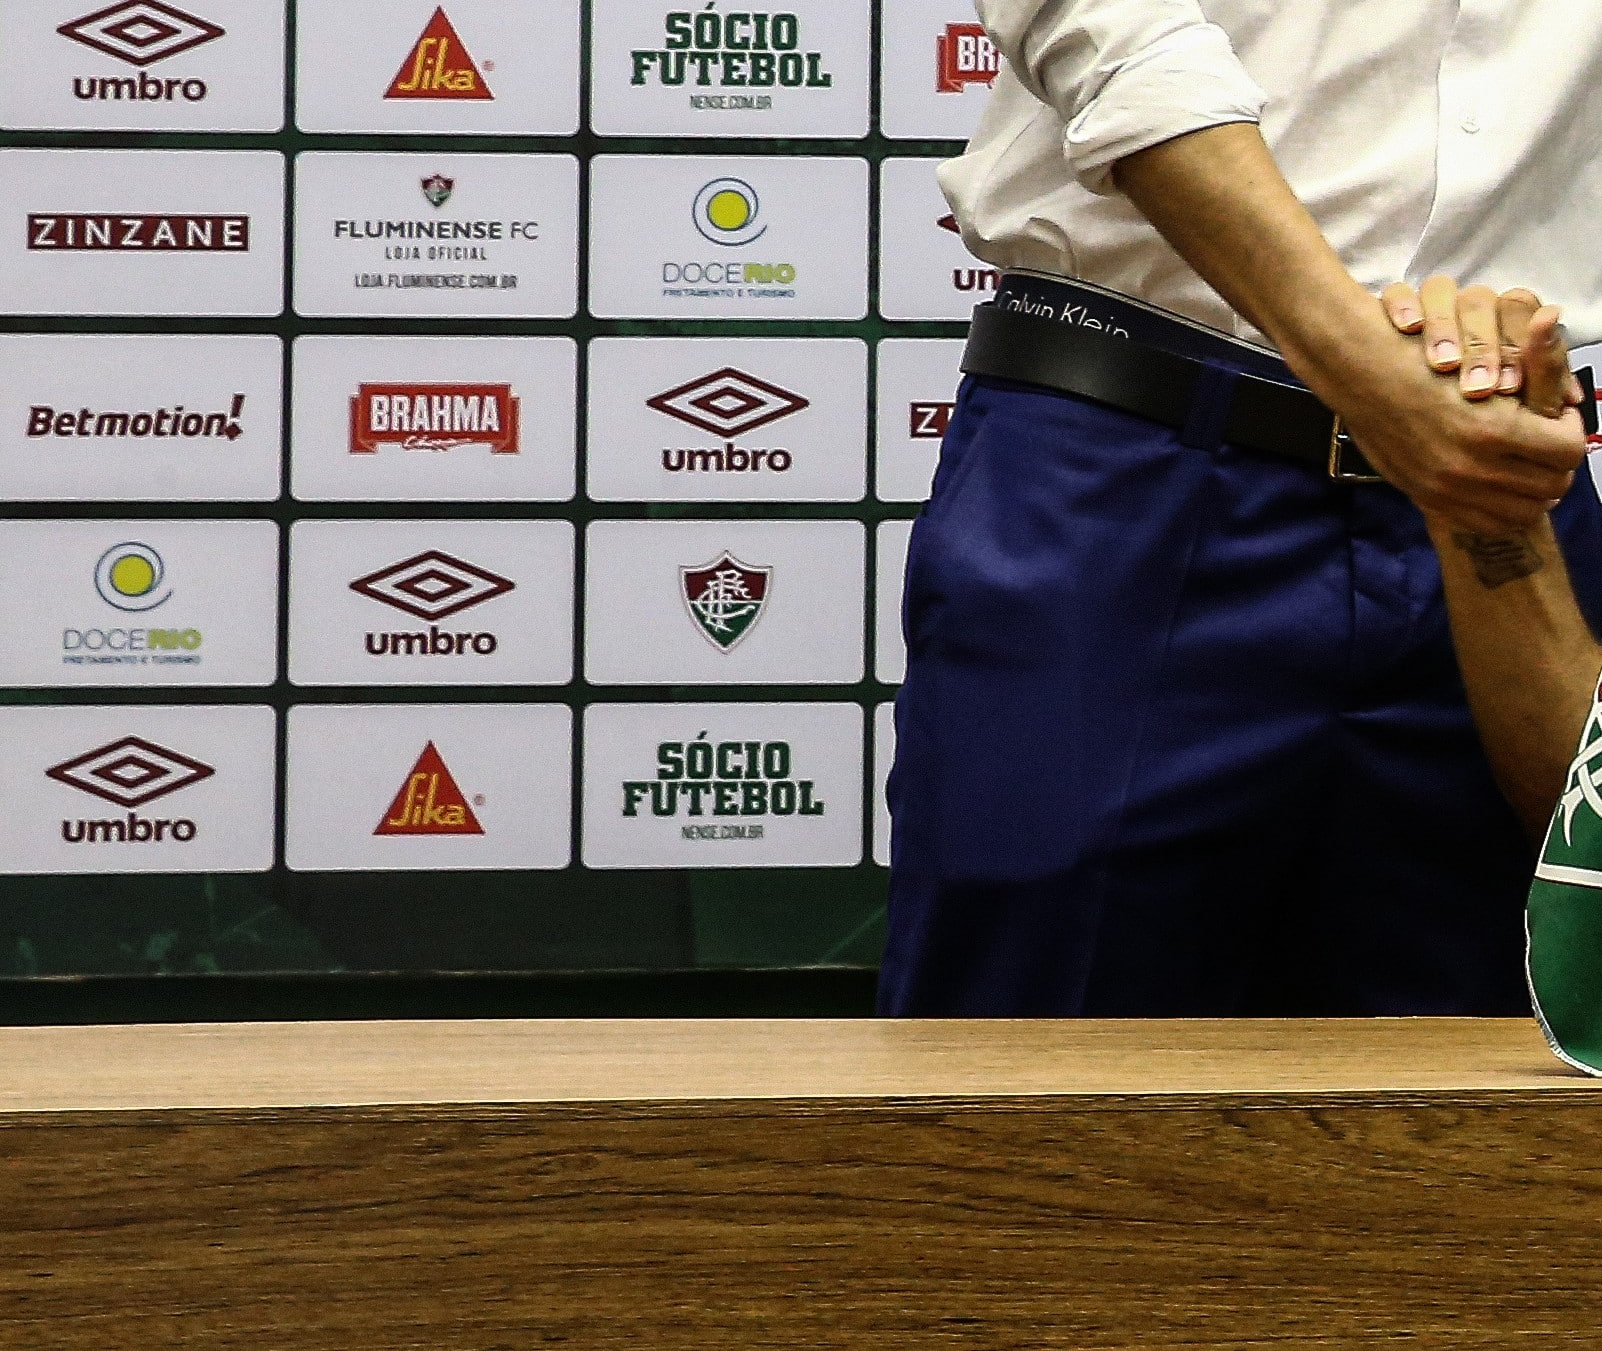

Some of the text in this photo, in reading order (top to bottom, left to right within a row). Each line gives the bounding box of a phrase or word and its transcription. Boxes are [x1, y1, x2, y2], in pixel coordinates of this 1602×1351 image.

[665, 1, 798, 51] SÓCIO
[72, 71, 208, 102] umbro
[630, 50, 832, 88] FUTEBOL
[35, 219, 242, 246] ZINZANE
[334, 219, 539, 242] FLUMINENSE FC
[25, 392, 245, 441] Betmotion!
[369, 394, 499, 432] BRAHMA
[662, 442, 793, 472] umbro
[657, 731, 793, 782] SÓCIO
[622, 781, 825, 818] FUTEBOL
[61, 812, 198, 843] umbro
